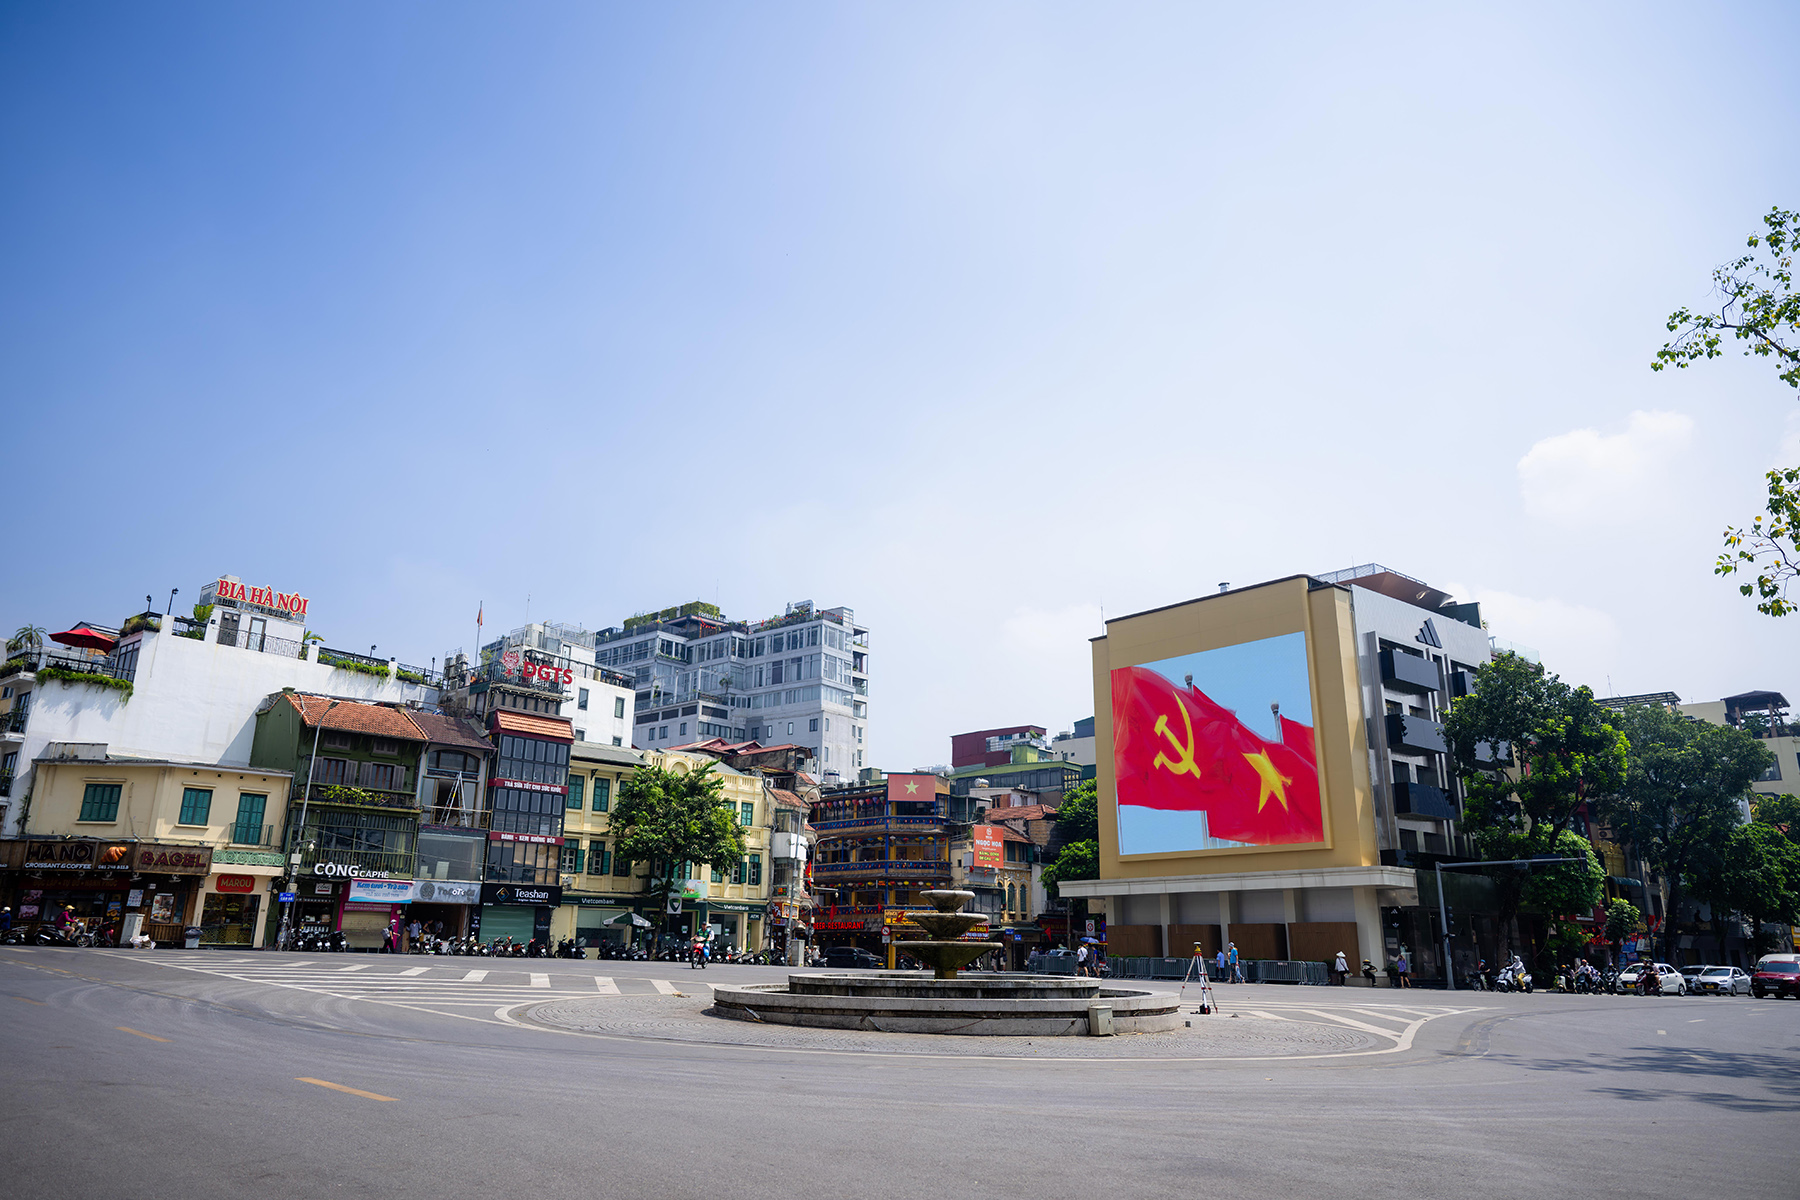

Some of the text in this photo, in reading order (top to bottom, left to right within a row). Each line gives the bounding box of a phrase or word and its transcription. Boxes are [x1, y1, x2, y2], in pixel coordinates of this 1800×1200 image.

[216, 579, 309, 616] BIA HÀ NỘI
[523, 661, 573, 684] DGTS
[142, 851, 207, 867] BAGEL
[314, 862, 359, 878] CỘNG
[221, 879, 252, 887] MAROU
[515, 888, 548, 899] Teashan
